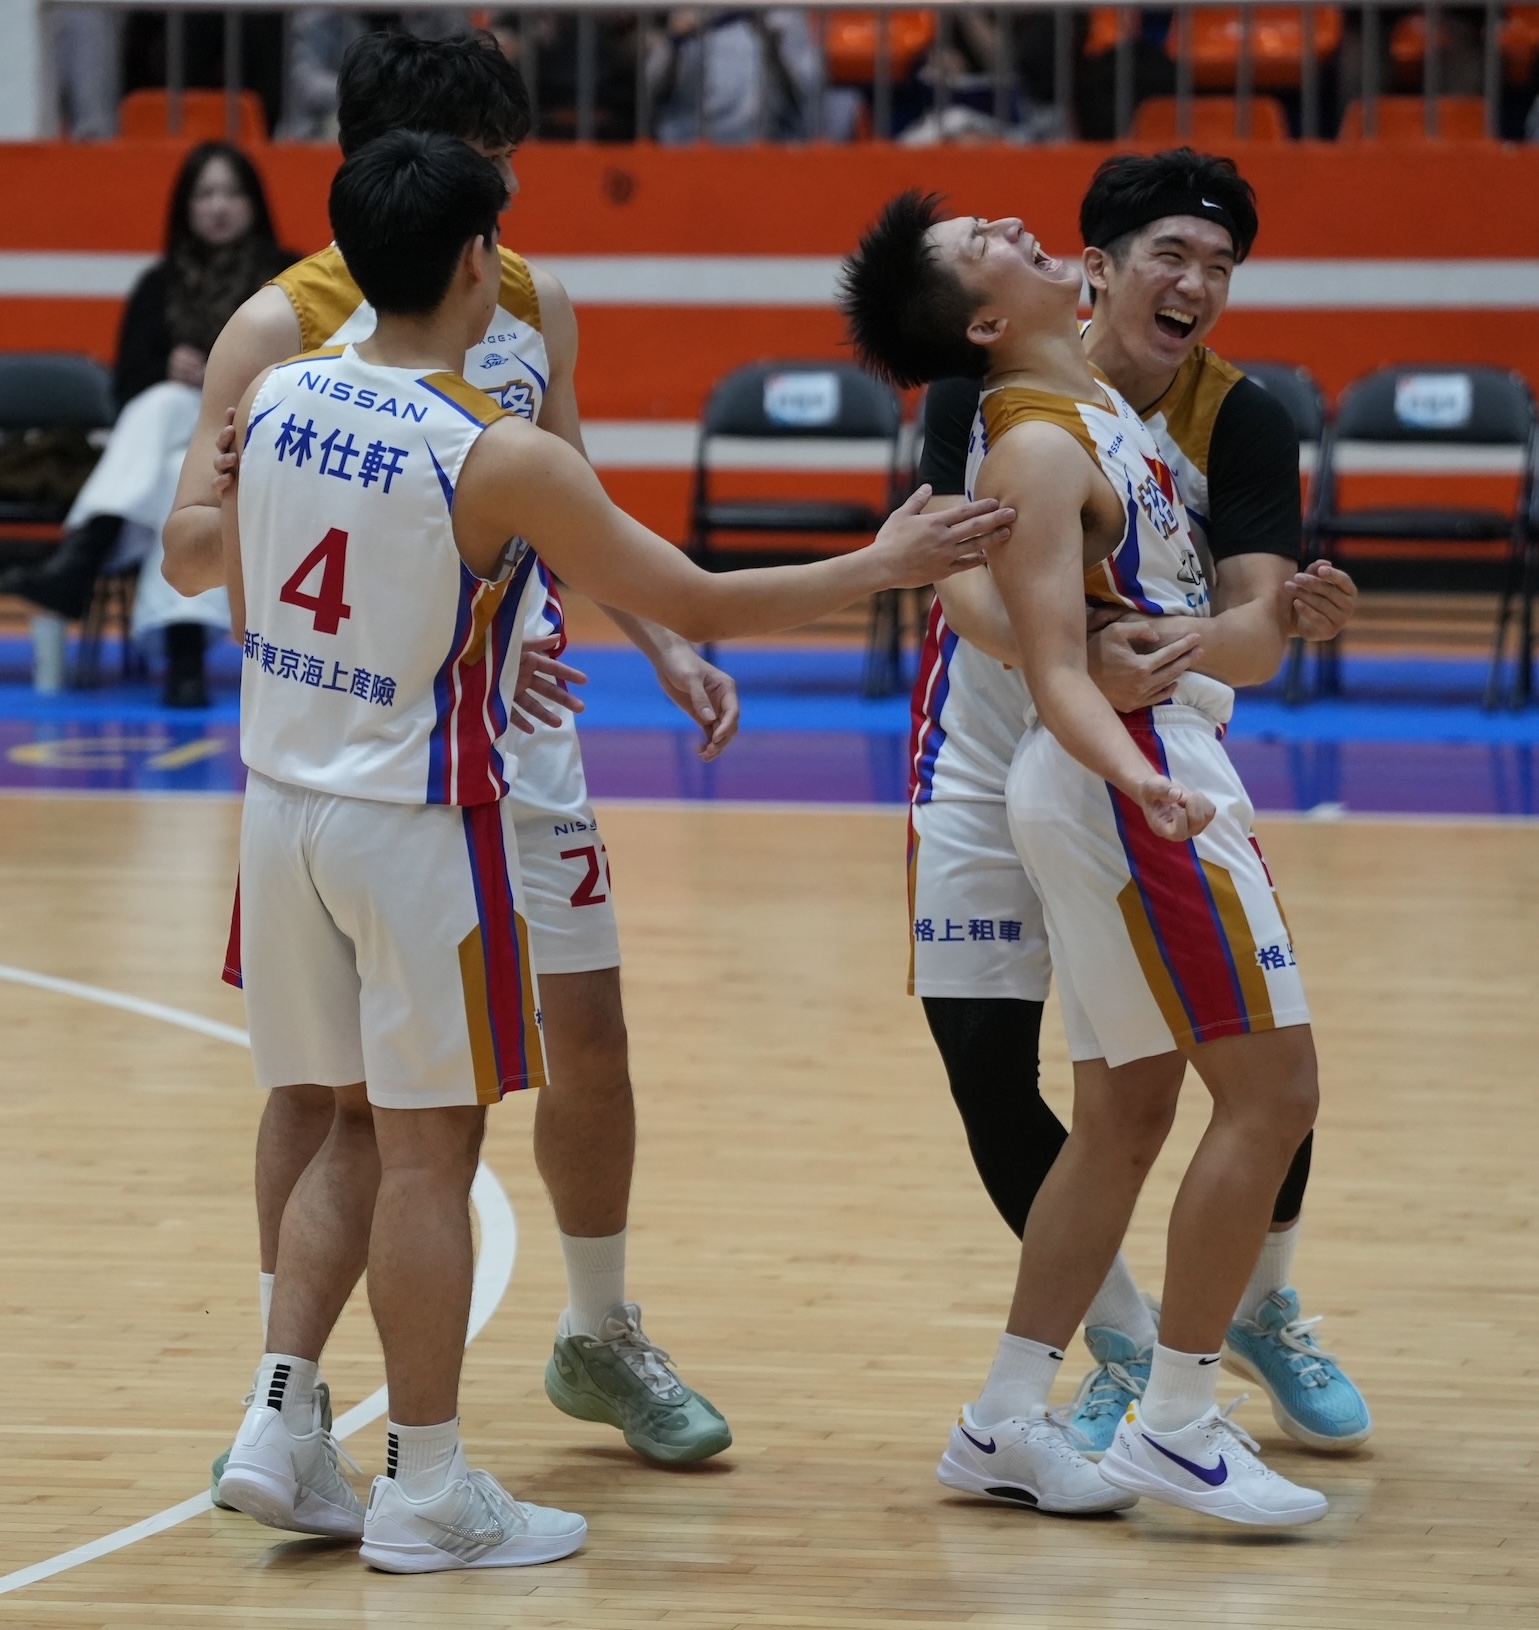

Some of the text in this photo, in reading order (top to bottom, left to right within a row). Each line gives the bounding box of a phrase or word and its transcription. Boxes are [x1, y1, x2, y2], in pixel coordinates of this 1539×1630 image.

[297, 370, 429, 424] NISSAN
[274, 412, 411, 495] 林仕軒
[279, 527, 352, 636] 4
[243, 628, 398, 708] 新東京海上産險
[554, 818, 598, 836] NIS
[560, 843, 612, 908] 2
[913, 917, 1024, 944] 格上租車
